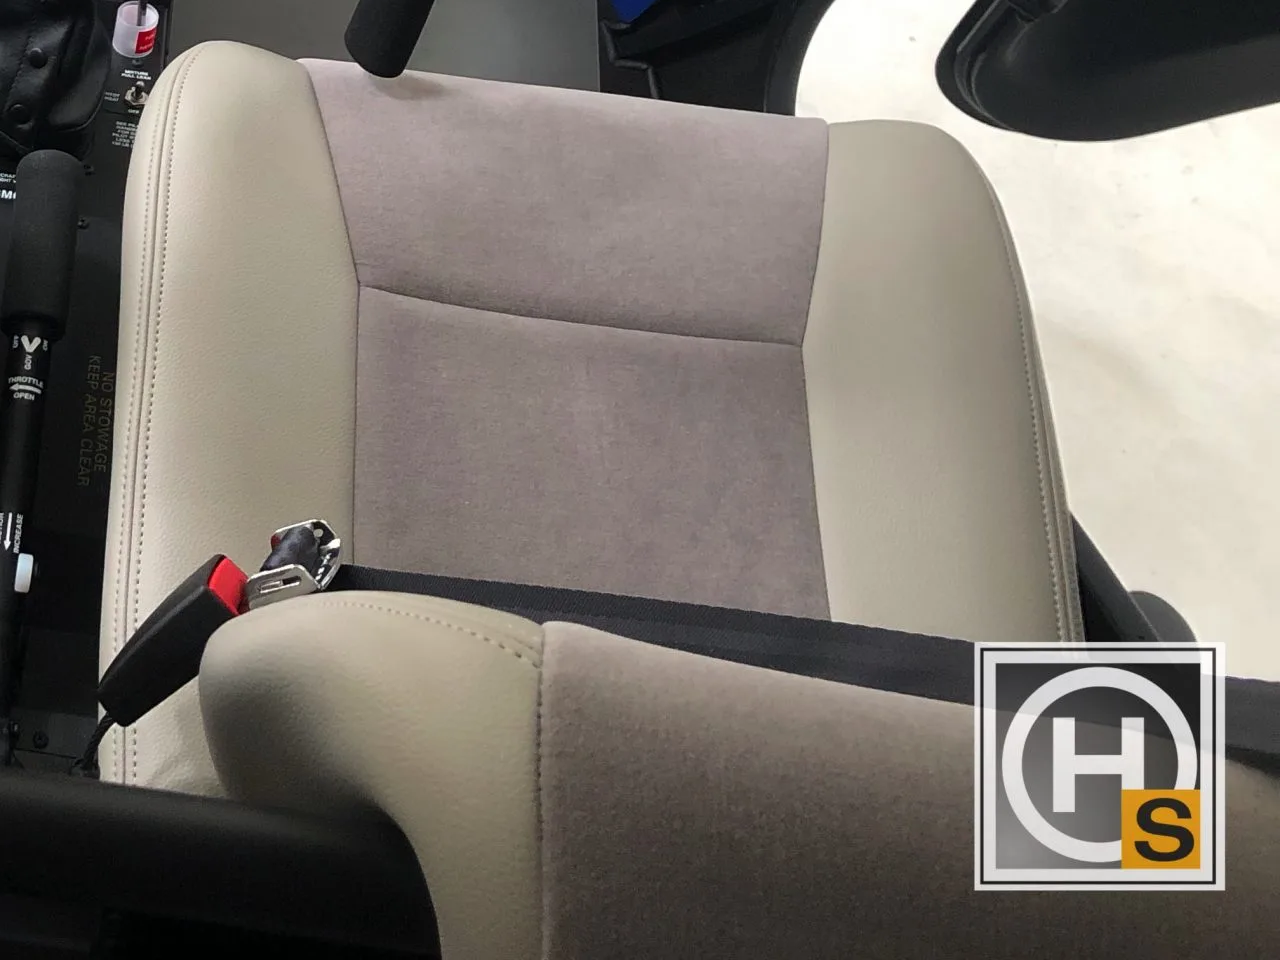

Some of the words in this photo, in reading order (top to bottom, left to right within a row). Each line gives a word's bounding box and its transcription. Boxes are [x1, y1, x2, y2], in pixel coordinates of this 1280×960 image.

[24, 354, 32, 370] GOV
[85, 354, 102, 390] KEEP
[8, 376, 44, 389] THROTTLE
[13, 391, 35, 401] OPEN
[100, 371, 116, 393] NO
[82, 393, 98, 434] AREA
[93, 397, 113, 473] STOWAGE
[76, 437, 94, 488] CLEAR
[13, 513, 24, 554] INCREASE
